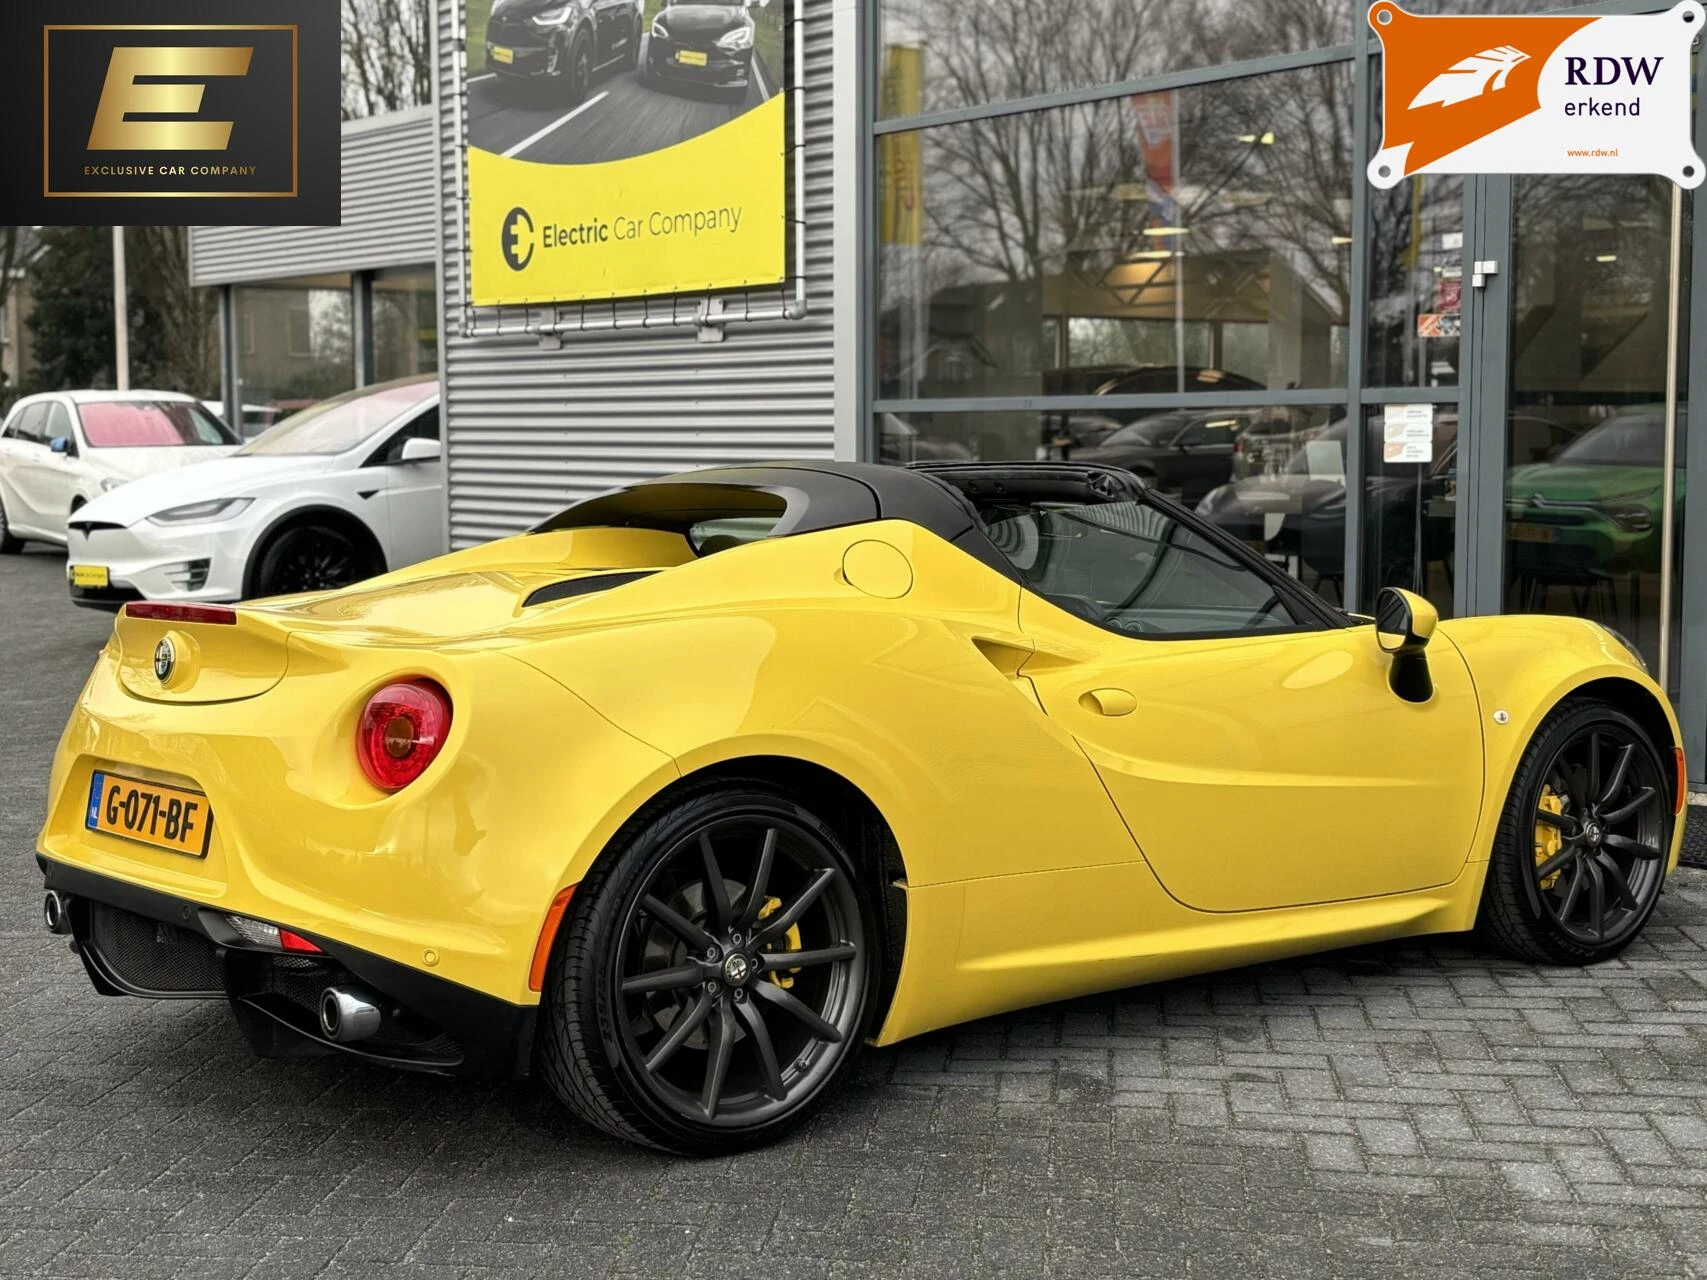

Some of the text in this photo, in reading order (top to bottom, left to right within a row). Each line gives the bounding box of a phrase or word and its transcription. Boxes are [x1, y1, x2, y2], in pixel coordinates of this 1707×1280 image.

[542, 206, 743, 249] Electric Car Company
[106, 785, 199, 844] G-071-BF
